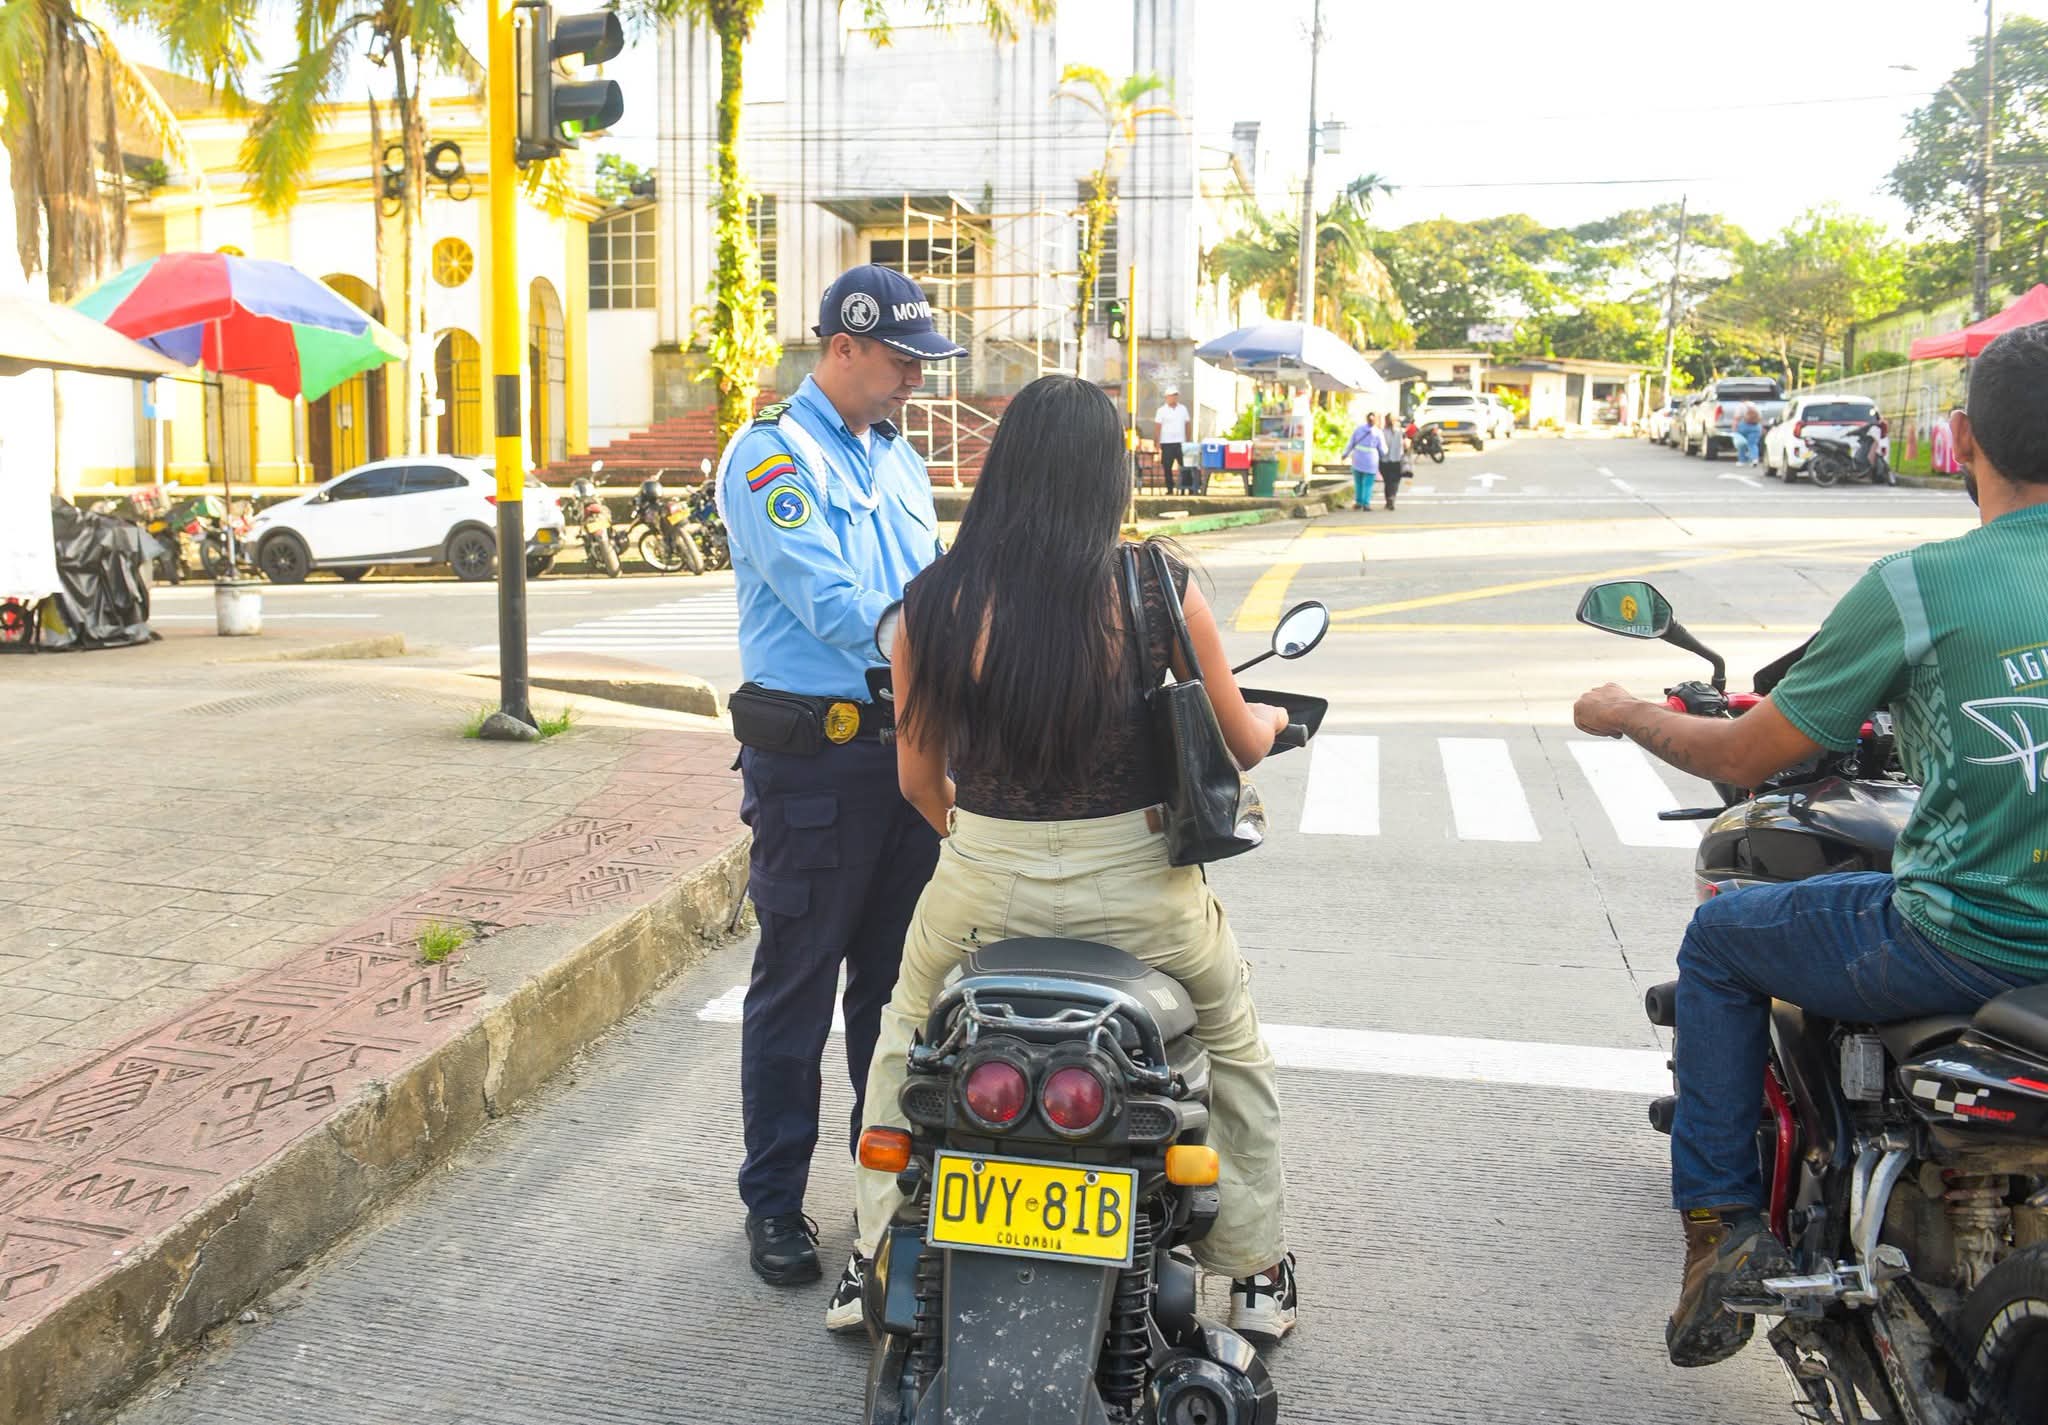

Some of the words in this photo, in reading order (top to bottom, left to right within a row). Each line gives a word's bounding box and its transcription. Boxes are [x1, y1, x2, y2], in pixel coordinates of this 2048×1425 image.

[2003, 648, 2048, 688] AG
[942, 1172, 1022, 1227] OVY
[1042, 1181, 1122, 1238] 81B
[996, 1231, 1062, 1250] COLOMBIA
